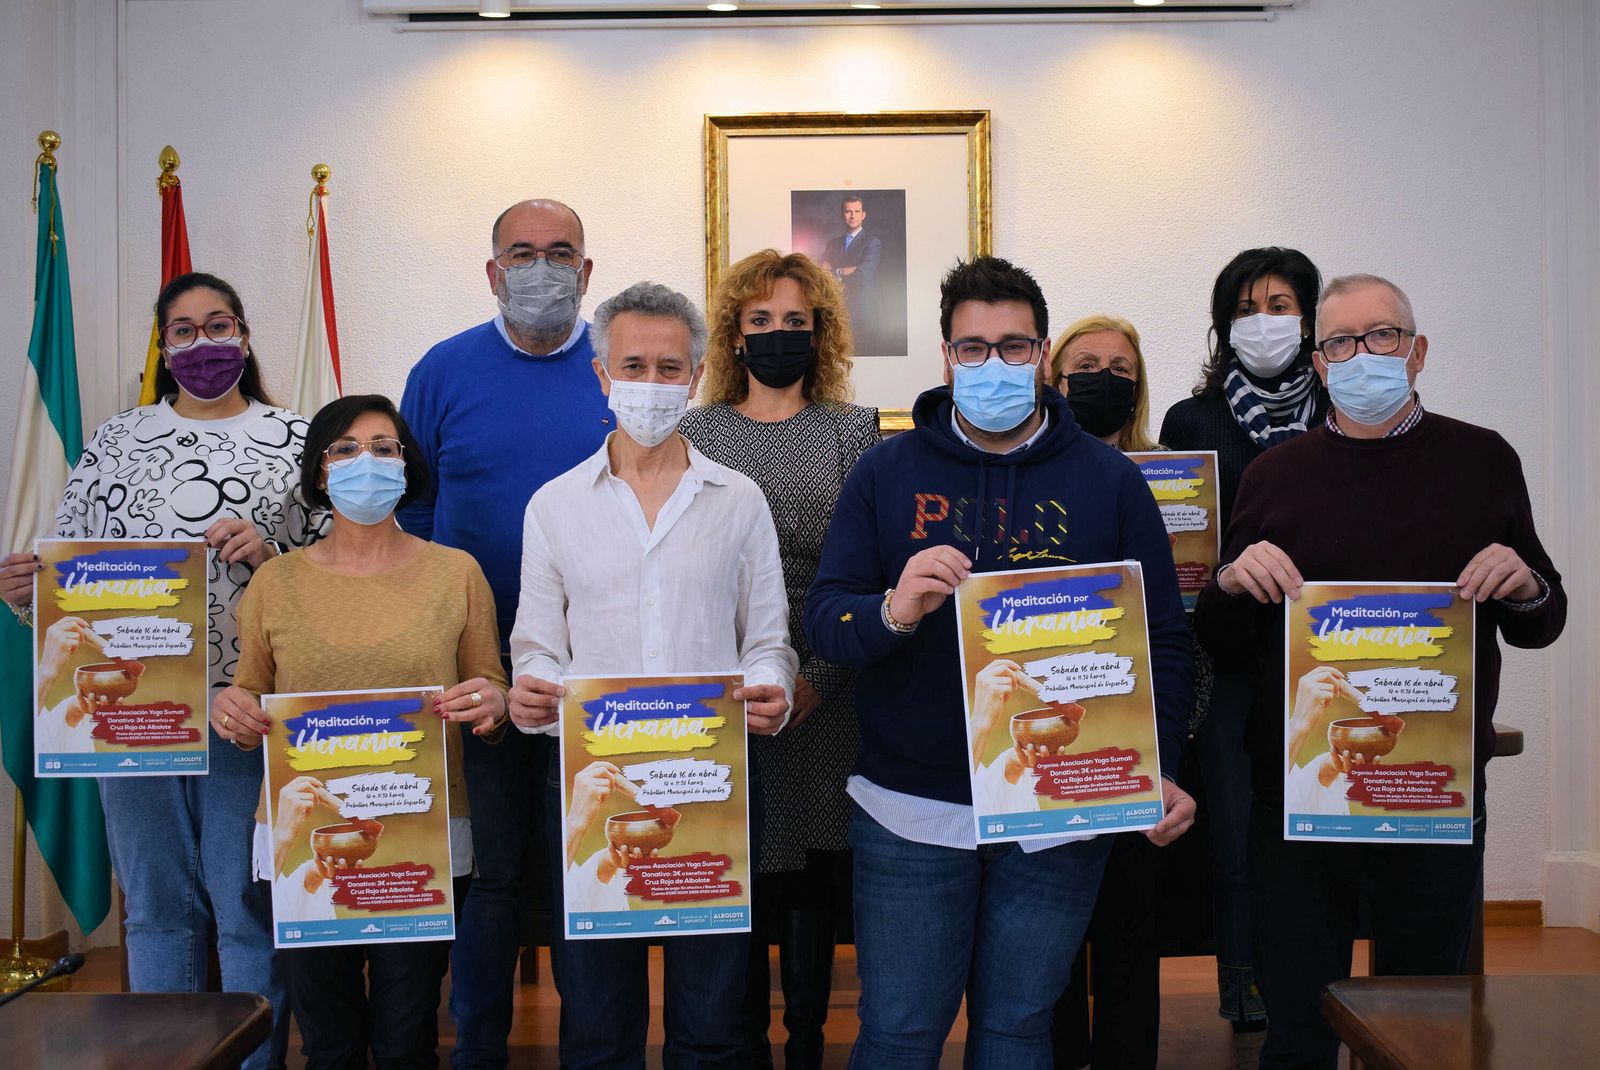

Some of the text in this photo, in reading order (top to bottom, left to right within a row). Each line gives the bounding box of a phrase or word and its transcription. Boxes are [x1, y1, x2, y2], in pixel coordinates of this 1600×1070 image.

[1002, 592, 1089, 609] Meditación por
[1332, 607, 1400, 618] Meditación
[990, 606, 1107, 637] Ucrania
[1319, 618, 1435, 648] Ucrania
[1081, 665, 1088, 673] 16
[1089, 663, 1098, 671] de
[1100, 661, 1120, 671] abril
[1090, 672, 1106, 680] horas
[1070, 681, 1096, 692] Municipal
[1105, 678, 1129, 689] Deportes
[1424, 679, 1443, 687] abril
[605, 699, 692, 712] Meditación por
[1391, 696, 1418, 704] Municipal
[1427, 697, 1450, 705] Deportes
[307, 714, 391, 728] Meditación por
[593, 711, 708, 741] Ucrania
[1060, 758, 1093, 767] Asociación
[1094, 757, 1109, 765] Yoga
[1110, 754, 1133, 763] Sumati
[688, 769, 696, 777] de
[698, 769, 718, 778] abril
[1050, 768, 1080, 777] Donativo:
[1053, 777, 1068, 785] Cruz
[1069, 776, 1083, 785] Roja
[1093, 772, 1120, 781] Albolote
[389, 782, 397, 790] de
[399, 781, 418, 790] abril
[1125, 807, 1156, 816] ALBOLOTE
[653, 861, 685, 869] Asociación
[686, 861, 701, 869] Yoga
[358, 871, 389, 879] Asociación
[390, 871, 405, 879] Yoga
[406, 869, 427, 877] Sumati
[642, 870, 671, 878] Donativo:
[365, 888, 379, 896] Roja
